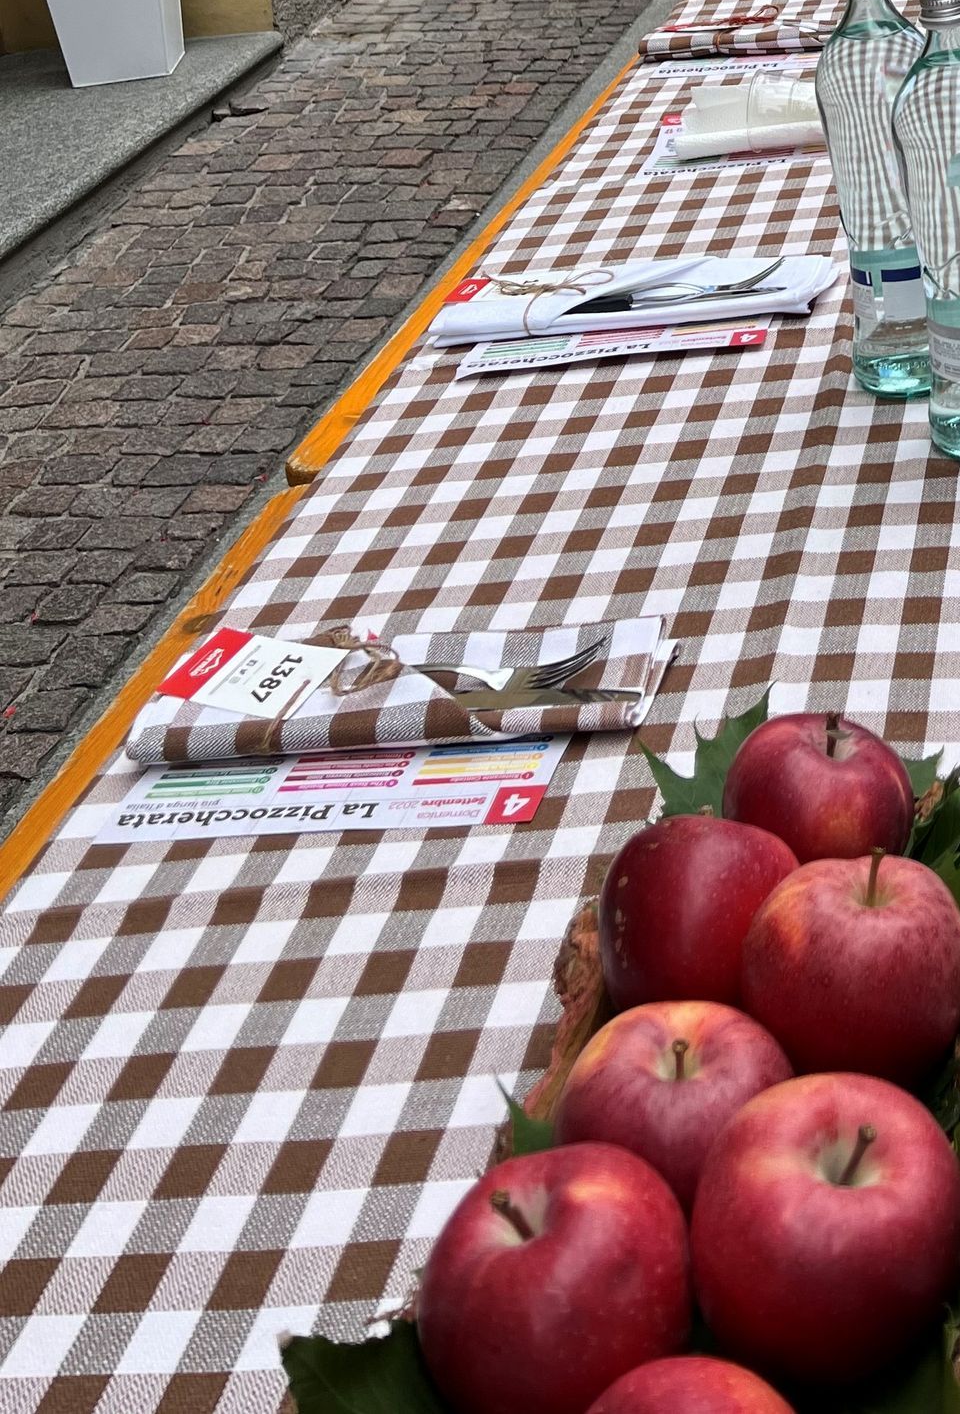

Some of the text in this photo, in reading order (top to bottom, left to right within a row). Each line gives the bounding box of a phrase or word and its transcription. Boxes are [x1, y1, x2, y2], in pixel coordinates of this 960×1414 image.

[658, 63, 758, 74] Pizzoccherata
[643, 160, 766, 177] Pizzoccherata
[738, 333, 758, 343] 4
[627, 342, 651, 350] La
[466, 345, 617, 369] Pizzoccherata
[250, 653, 304, 704] 1387
[388, 795, 487, 809] Settembre 2022
[502, 793, 532, 817] 4
[117, 801, 380, 829] La Pizzoccherata
[416, 808, 481, 819] Domenica
